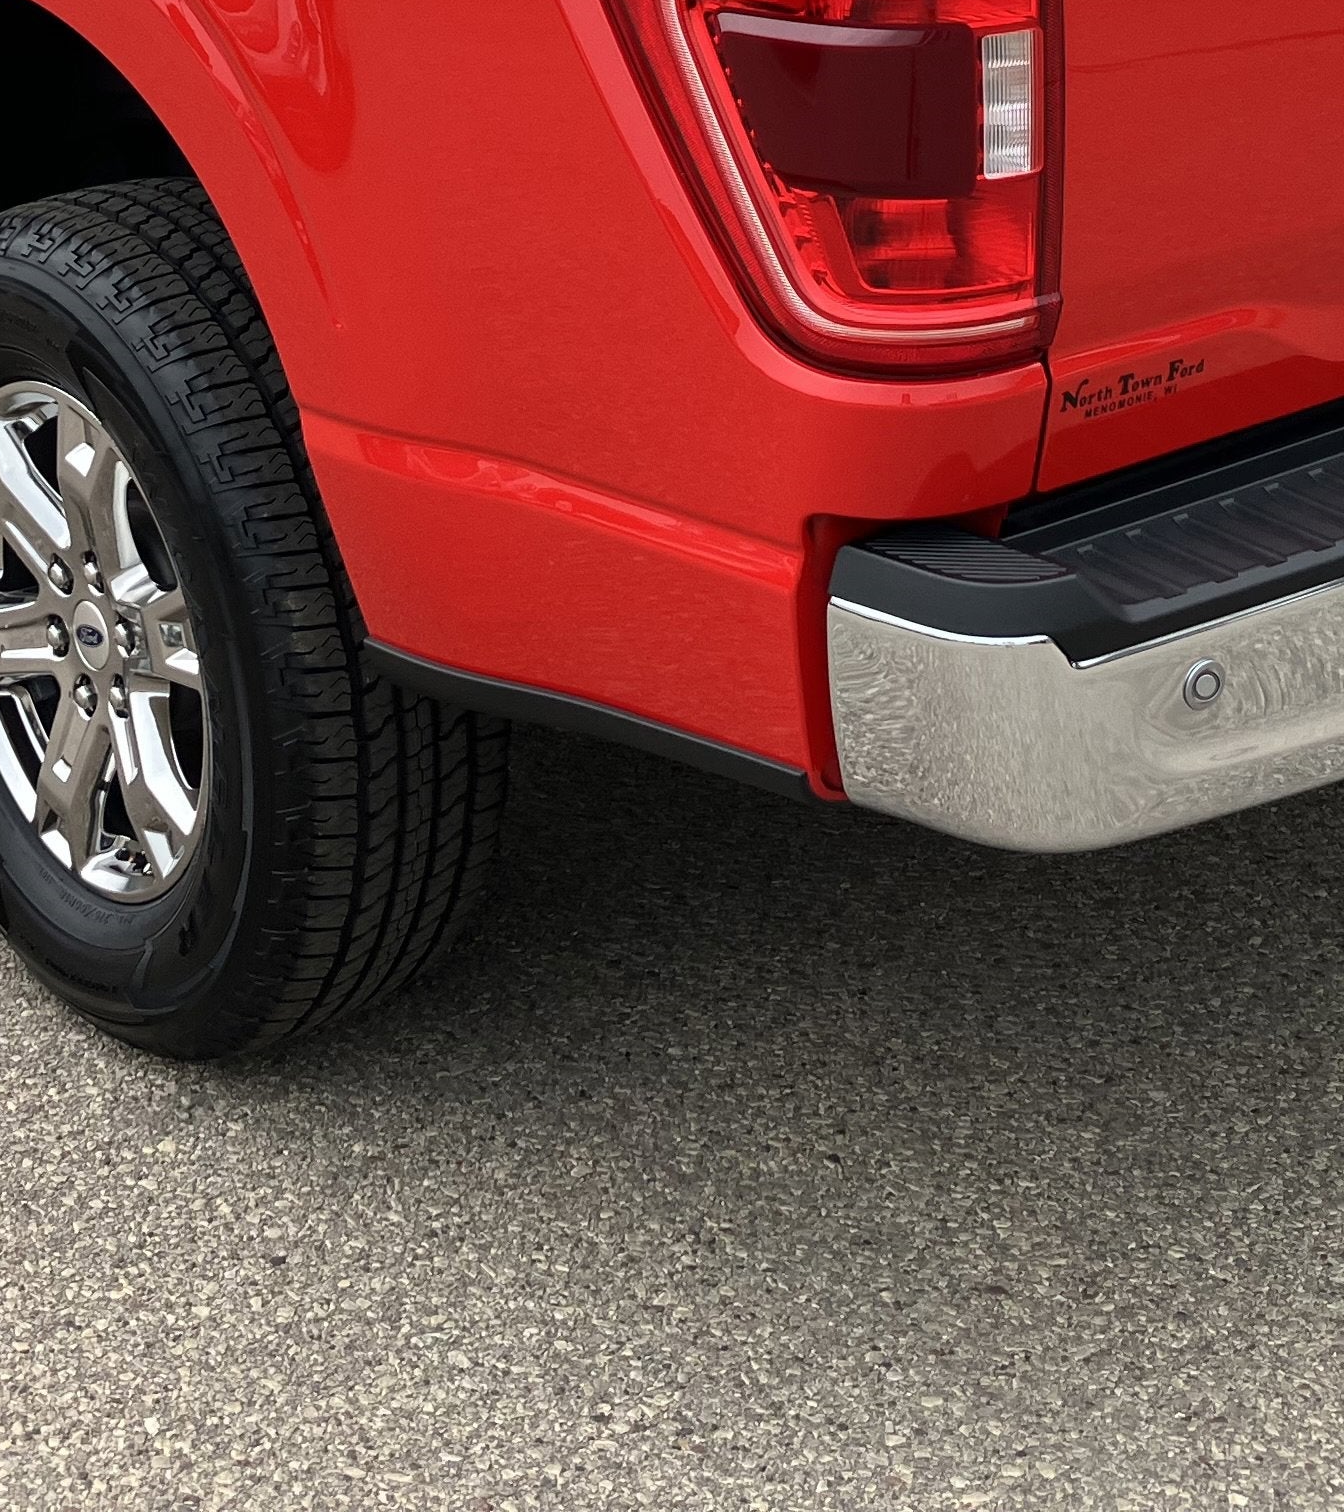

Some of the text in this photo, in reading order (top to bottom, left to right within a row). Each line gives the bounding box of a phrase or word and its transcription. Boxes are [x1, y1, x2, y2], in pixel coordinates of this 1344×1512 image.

[1059, 358, 1205, 413] North Town Ford
